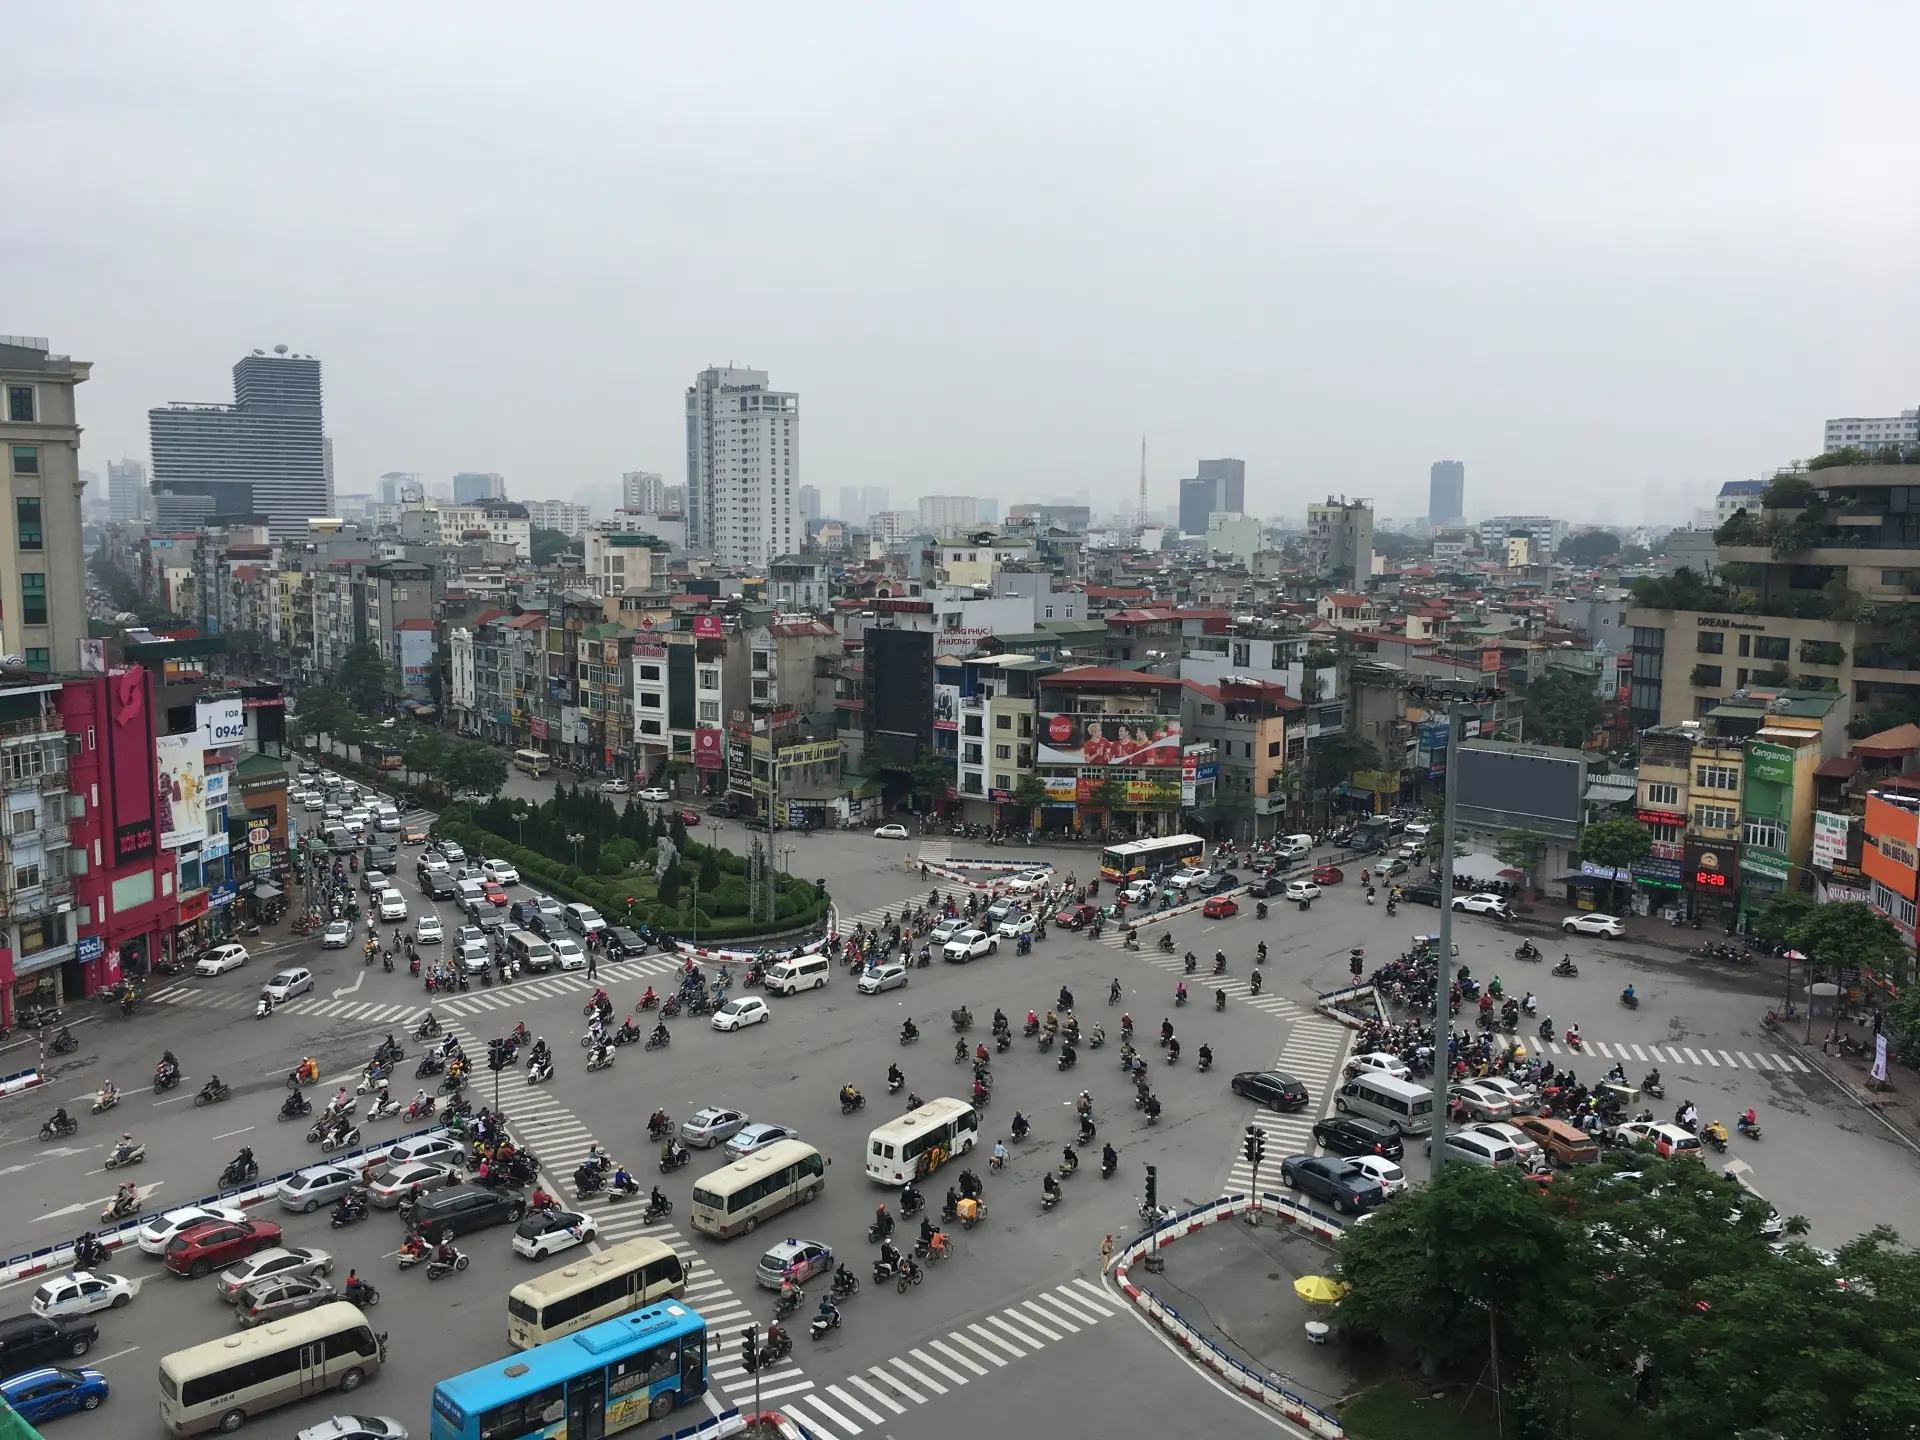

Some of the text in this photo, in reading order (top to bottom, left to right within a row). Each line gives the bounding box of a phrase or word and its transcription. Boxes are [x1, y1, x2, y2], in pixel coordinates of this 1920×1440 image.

[1697, 617, 1730, 628] DREAM
[225, 710, 239, 718] FOR
[215, 724, 244, 738] 0942
[1049, 724, 1071, 733] Coca-Cola
[804, 747, 813, 760] THẺ
[1751, 746, 1791, 762] Kangaroo
[1760, 764, 1785, 775] Hydrogen
[1587, 773, 1637, 787] MOUNTAIN
[248, 818, 268, 829] NGAN
[1746, 848, 1784, 867] Kangaroo
[1593, 866, 1628, 880] MOUNAIN
[1696, 872, 1726, 886] 12:28
[1829, 887, 1850, 901] QUẠT
[79, 941, 98, 955] TÓC
